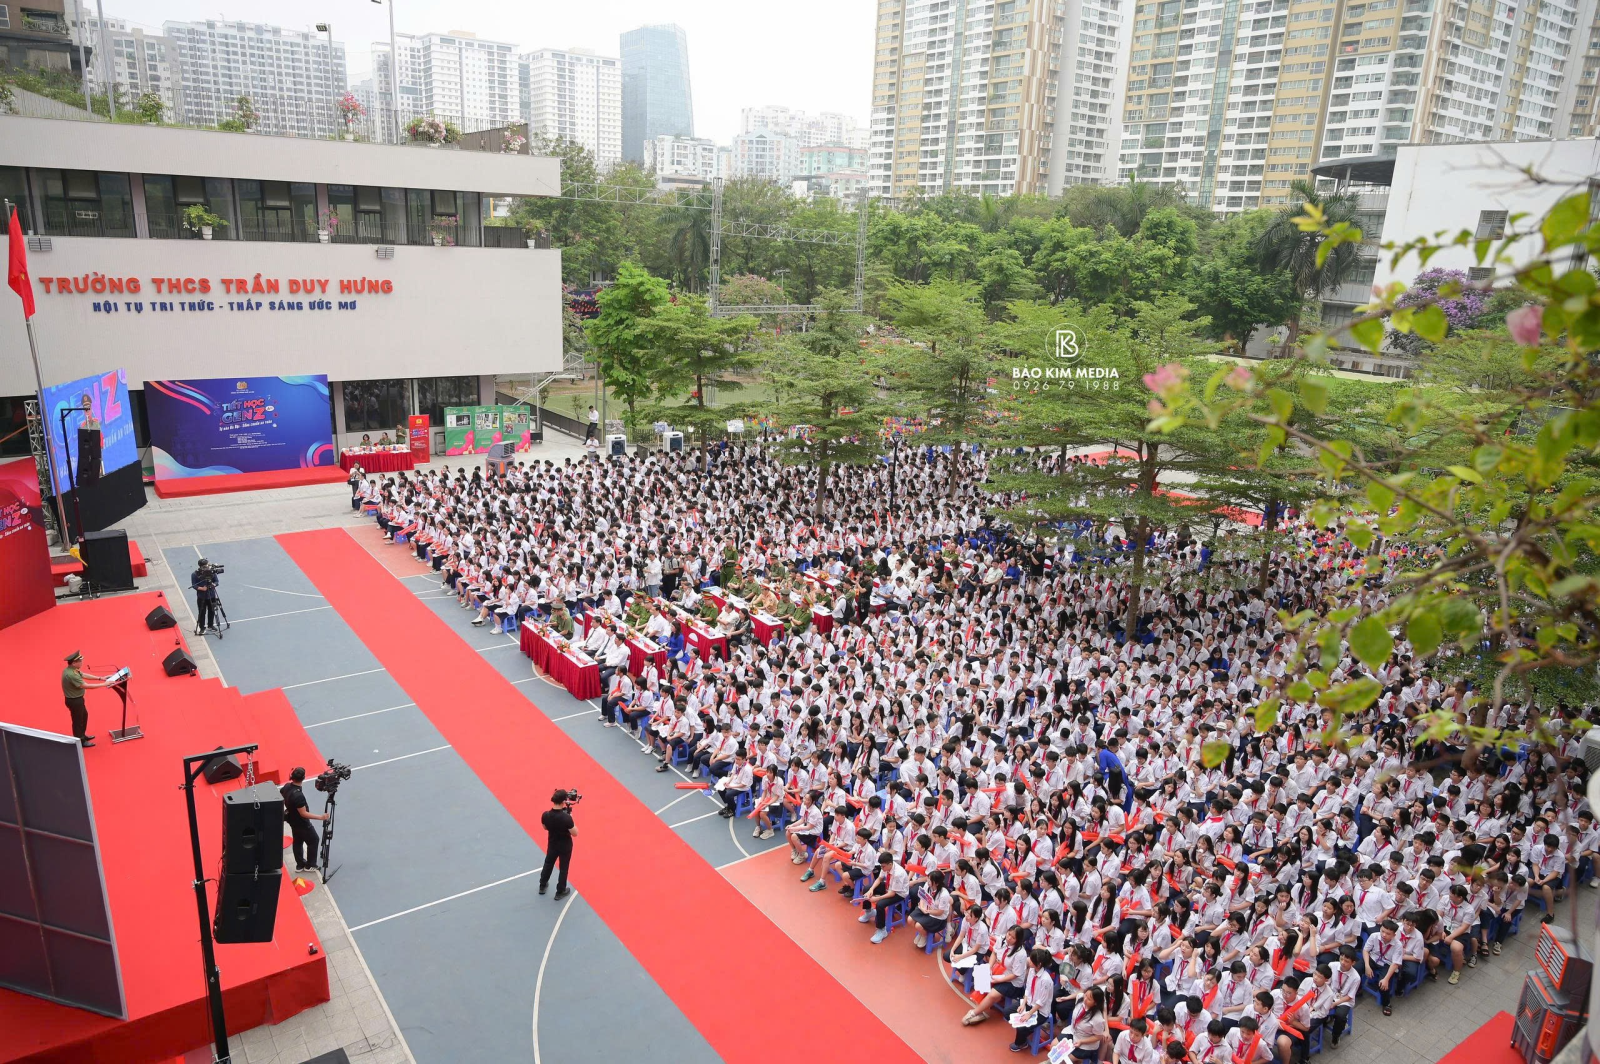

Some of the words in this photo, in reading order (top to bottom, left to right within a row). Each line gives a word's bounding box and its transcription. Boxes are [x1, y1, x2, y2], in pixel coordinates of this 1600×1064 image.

[39, 272, 141, 294] TRƯỜNG
[151, 277, 211, 294] THCS
[221, 272, 280, 294] TRẦN
[288, 279, 330, 294] DUY
[339, 277, 393, 294] HƯNG
[93, 300, 119, 314] HỘI
[125, 302, 144, 314] TỤ
[150, 301, 173, 312] TRI
[179, 299, 215, 312] THỨC
[268, 299, 304, 311] SÁNG
[308, 298, 332, 311] ƯỚC
[338, 300, 357, 310] MƠ
[244, 398, 265, 408] HỌC
